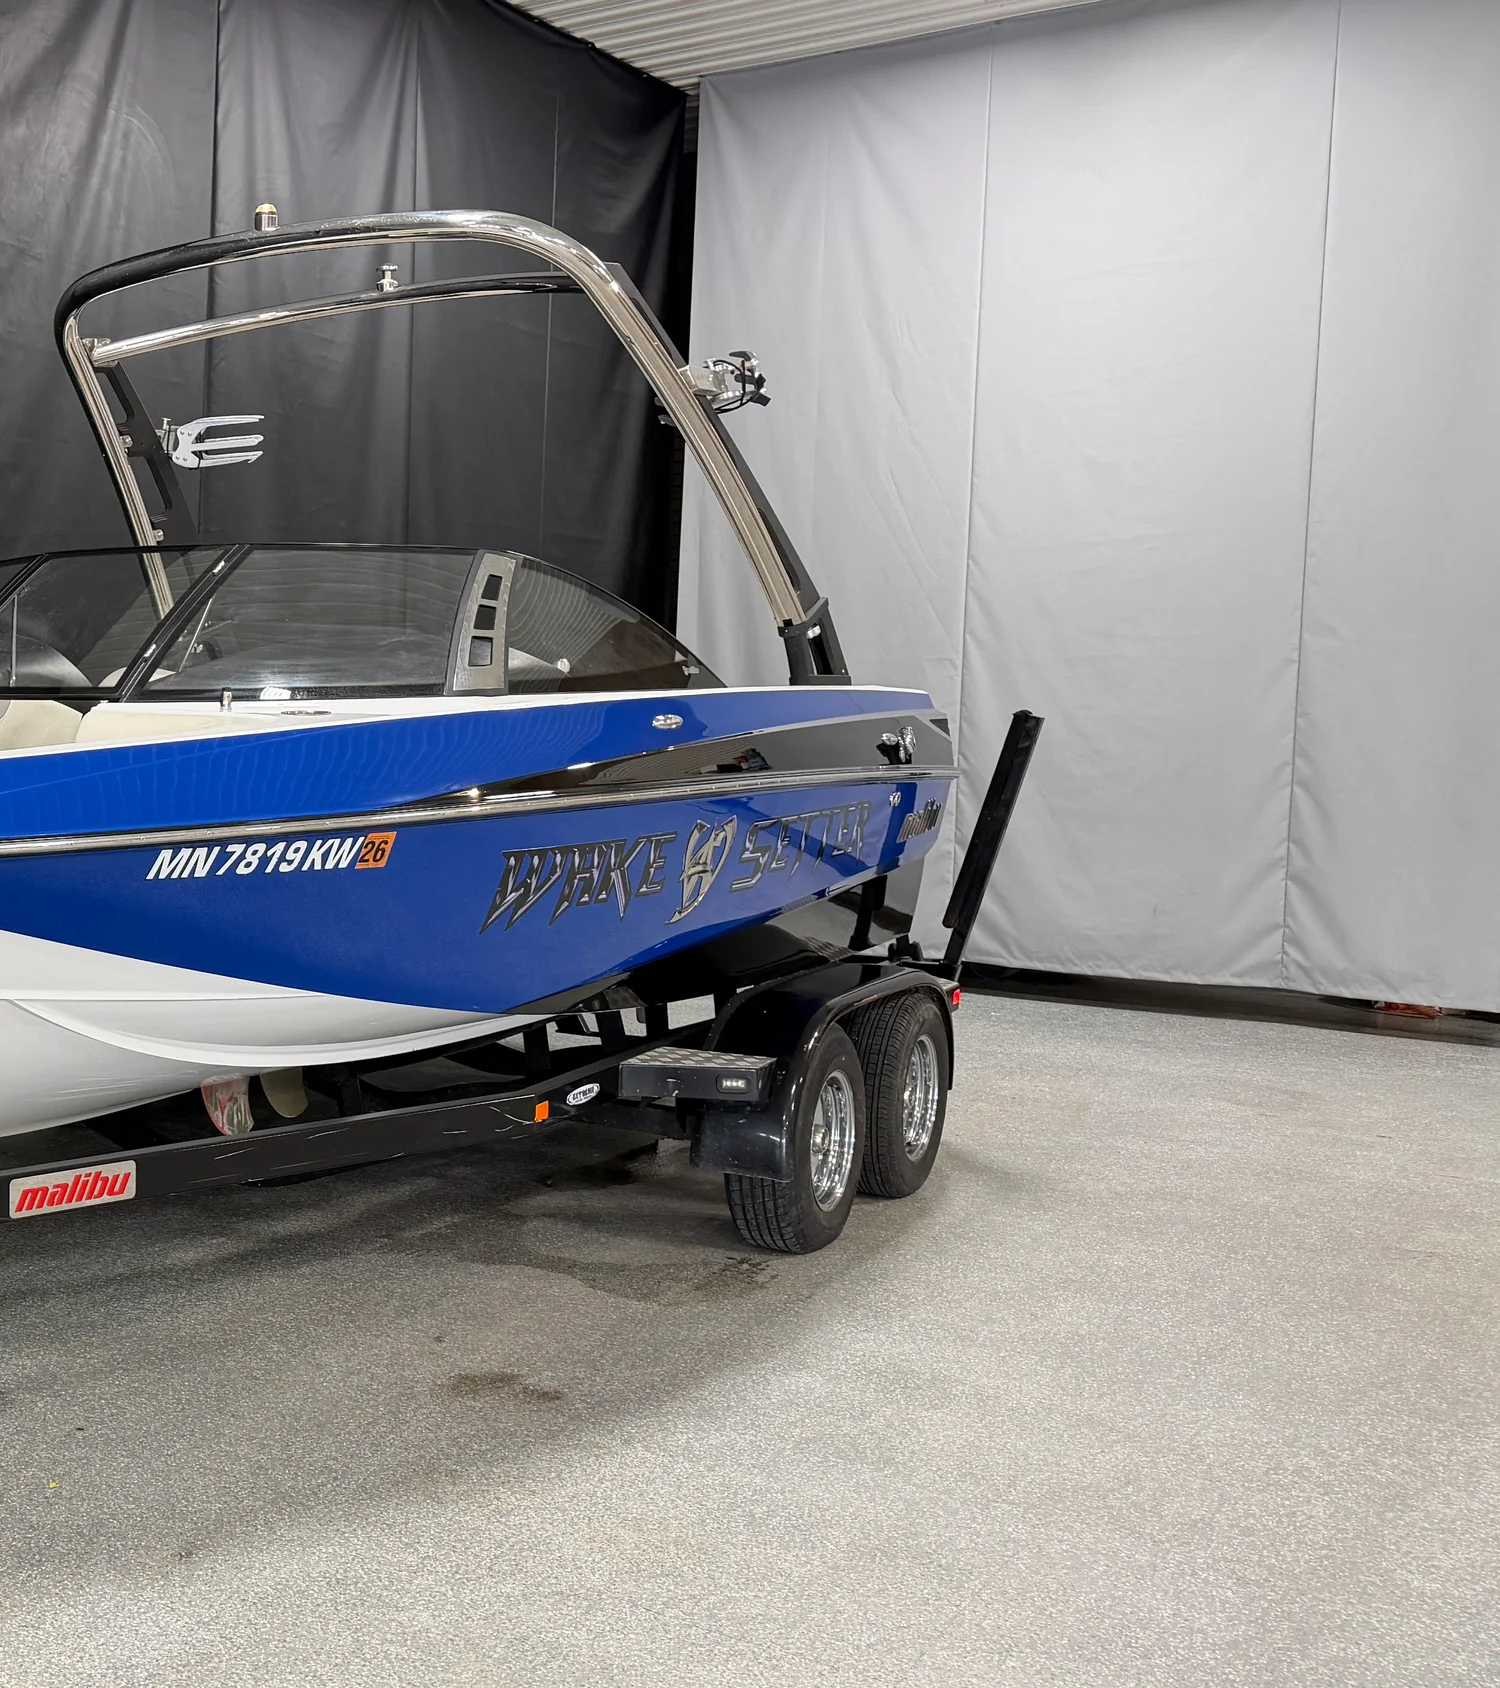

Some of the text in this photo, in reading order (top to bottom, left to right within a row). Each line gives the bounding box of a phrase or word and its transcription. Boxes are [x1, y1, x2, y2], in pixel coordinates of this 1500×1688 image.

[146, 847, 220, 879] MN
[358, 839, 389, 864] 26
[479, 800, 872, 934] WAKE SETTER
[14, 1170, 132, 1214] malibu
